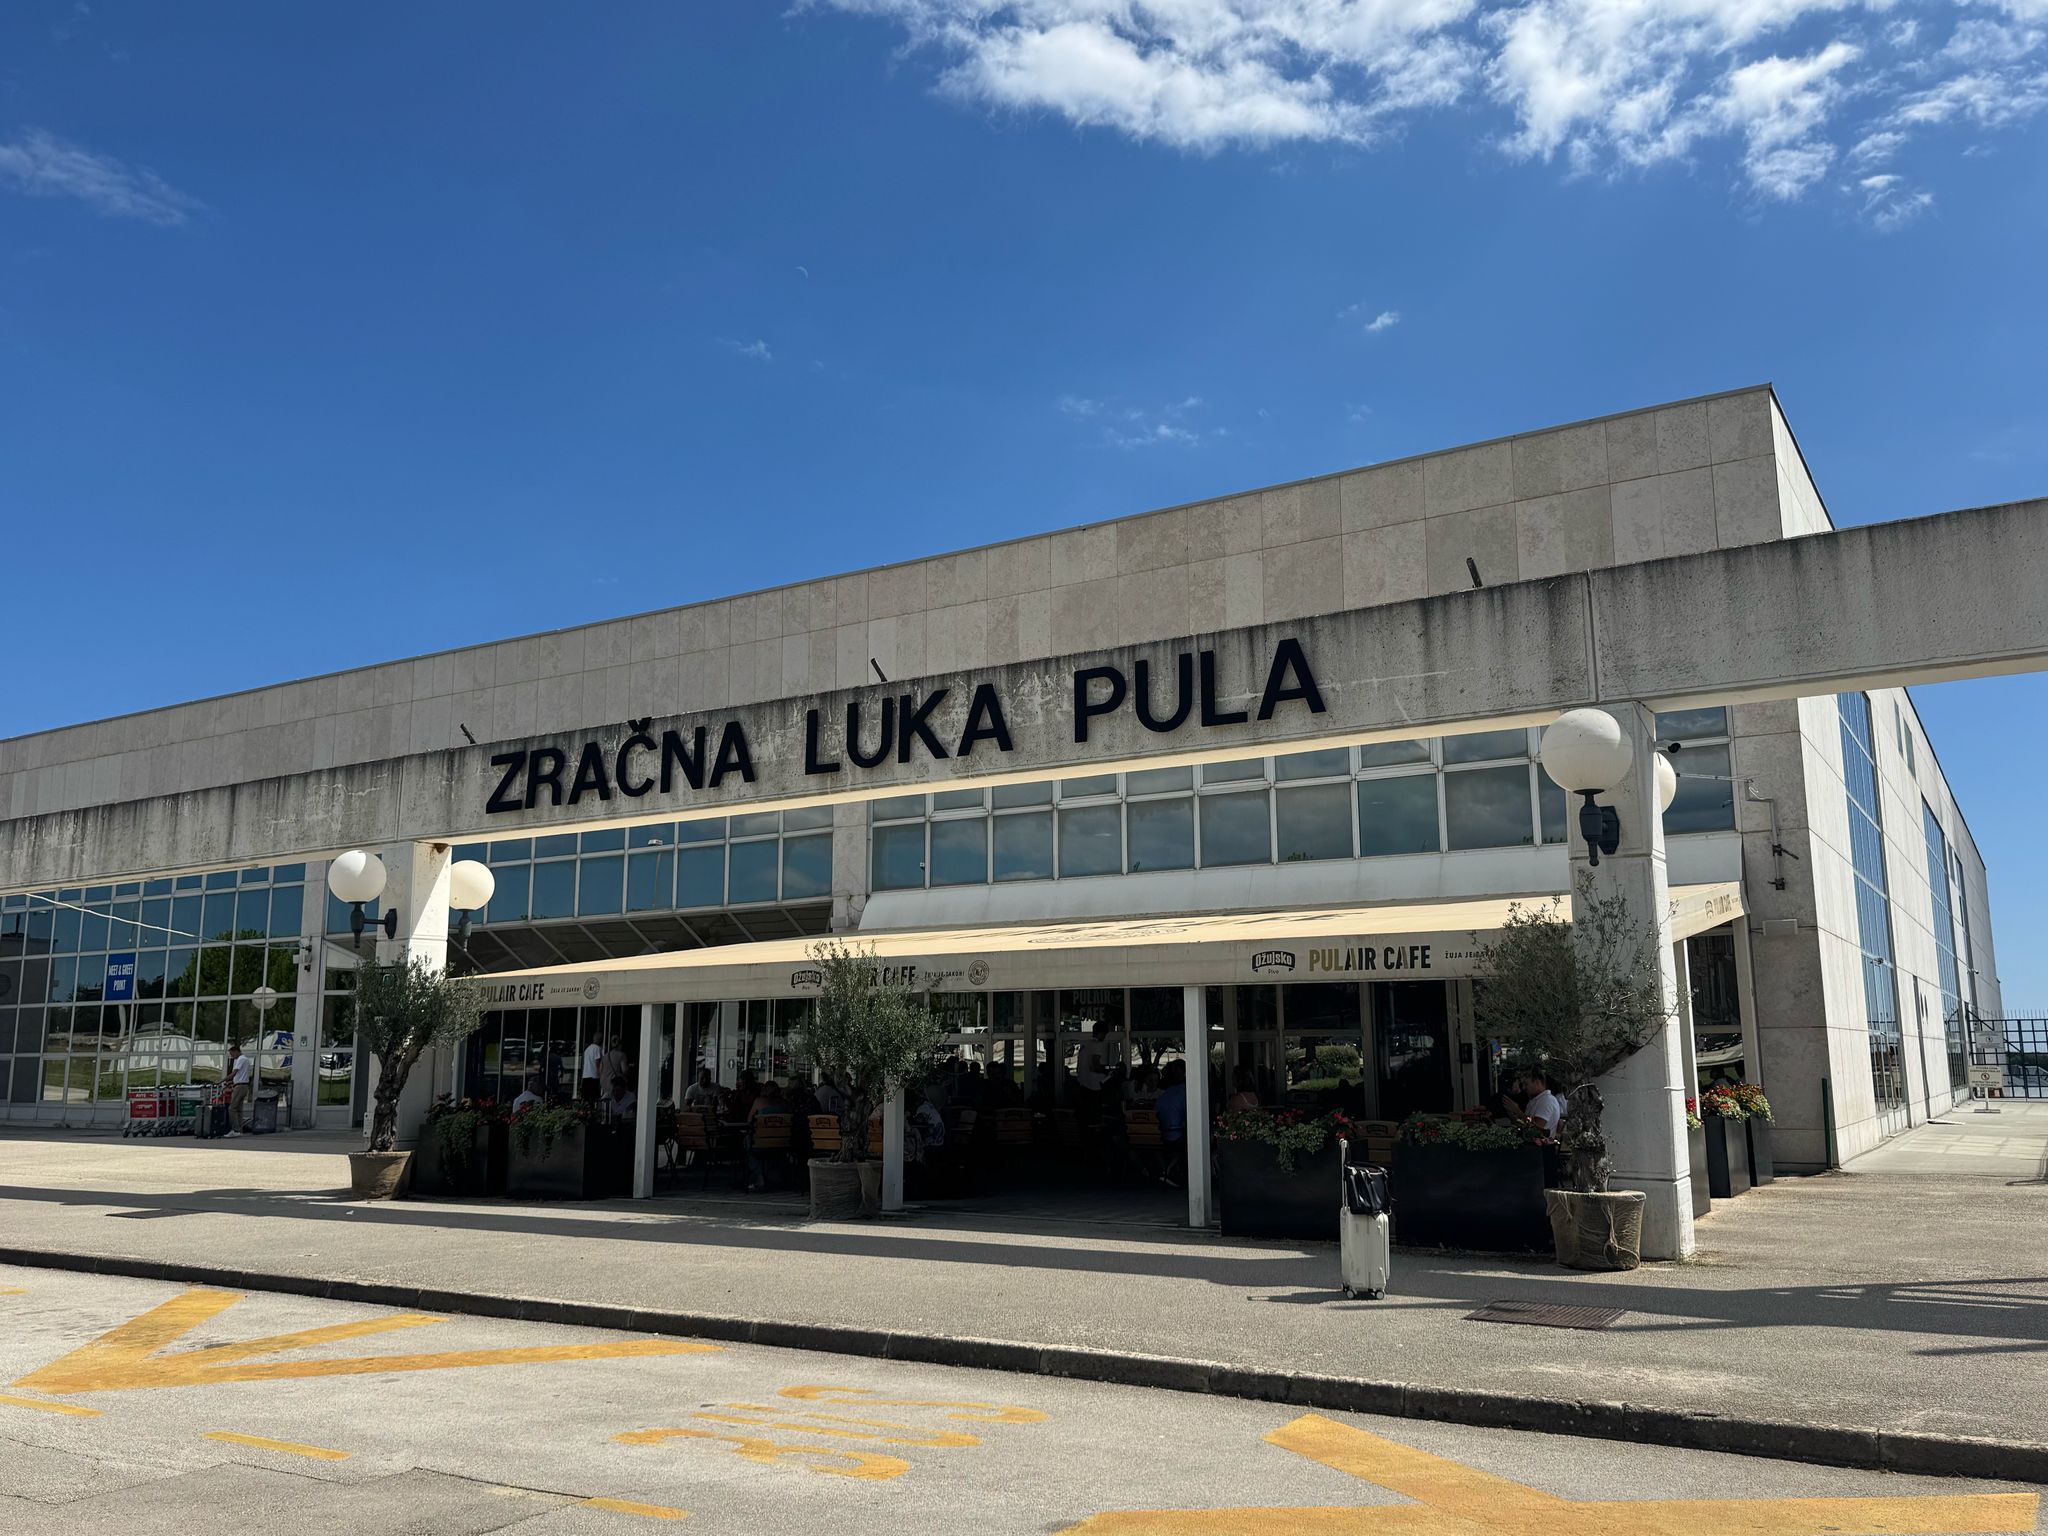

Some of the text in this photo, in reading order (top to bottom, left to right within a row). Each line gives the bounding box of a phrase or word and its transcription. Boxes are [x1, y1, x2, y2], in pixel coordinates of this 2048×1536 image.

[485, 638, 1327, 814] ZRAČNA LUKA PULA
[1309, 945, 1431, 972] PULAIR CAFE
[480, 982, 545, 1003] PULAIR CAFE
